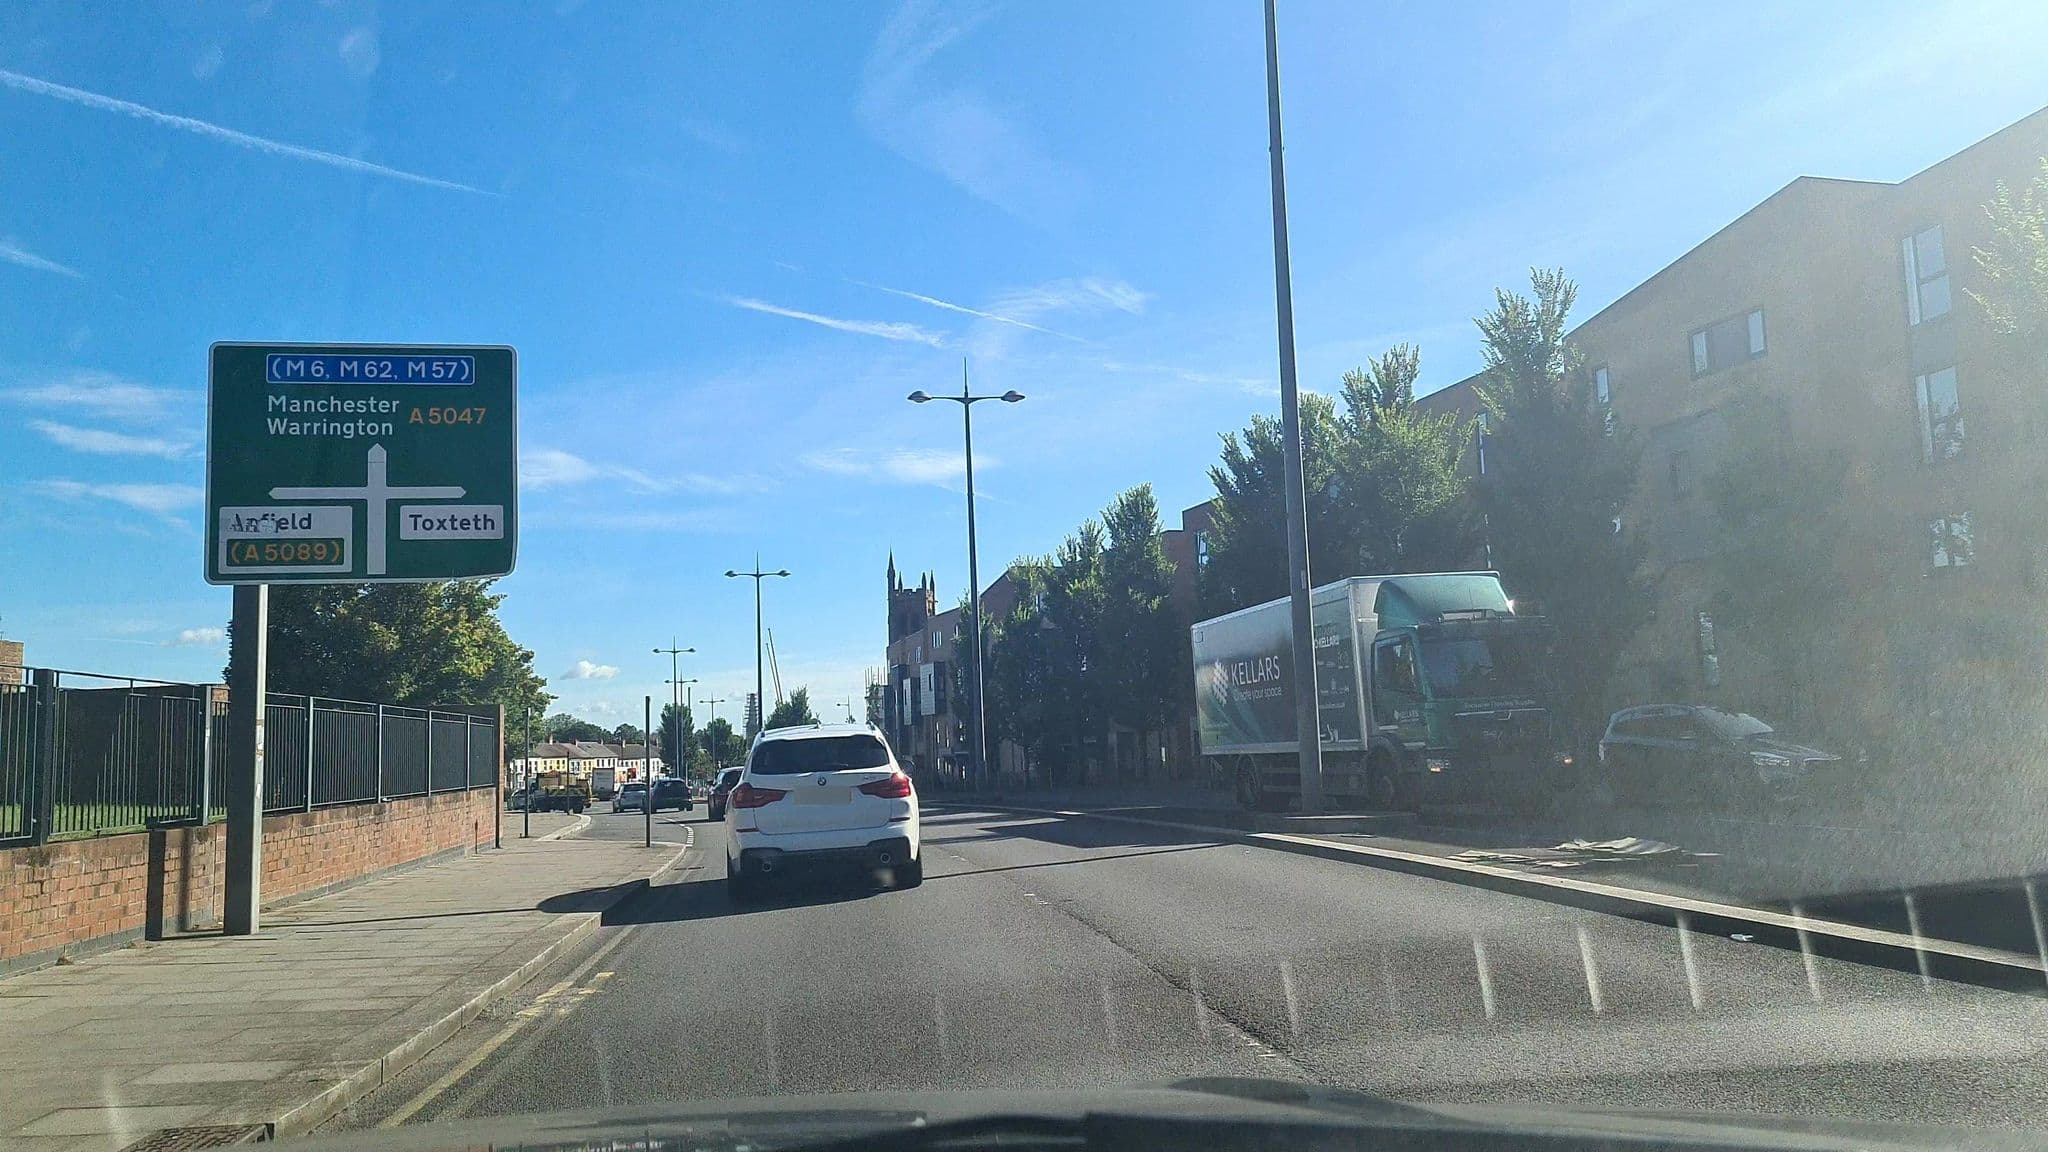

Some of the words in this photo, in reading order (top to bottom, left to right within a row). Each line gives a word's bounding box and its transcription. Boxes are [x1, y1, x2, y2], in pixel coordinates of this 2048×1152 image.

[268, 394, 400, 413] Manchester
[267, 418, 394, 438] Warrington
[409, 513, 496, 531] Toxteth
[1230, 655, 1281, 686] KELLARS
